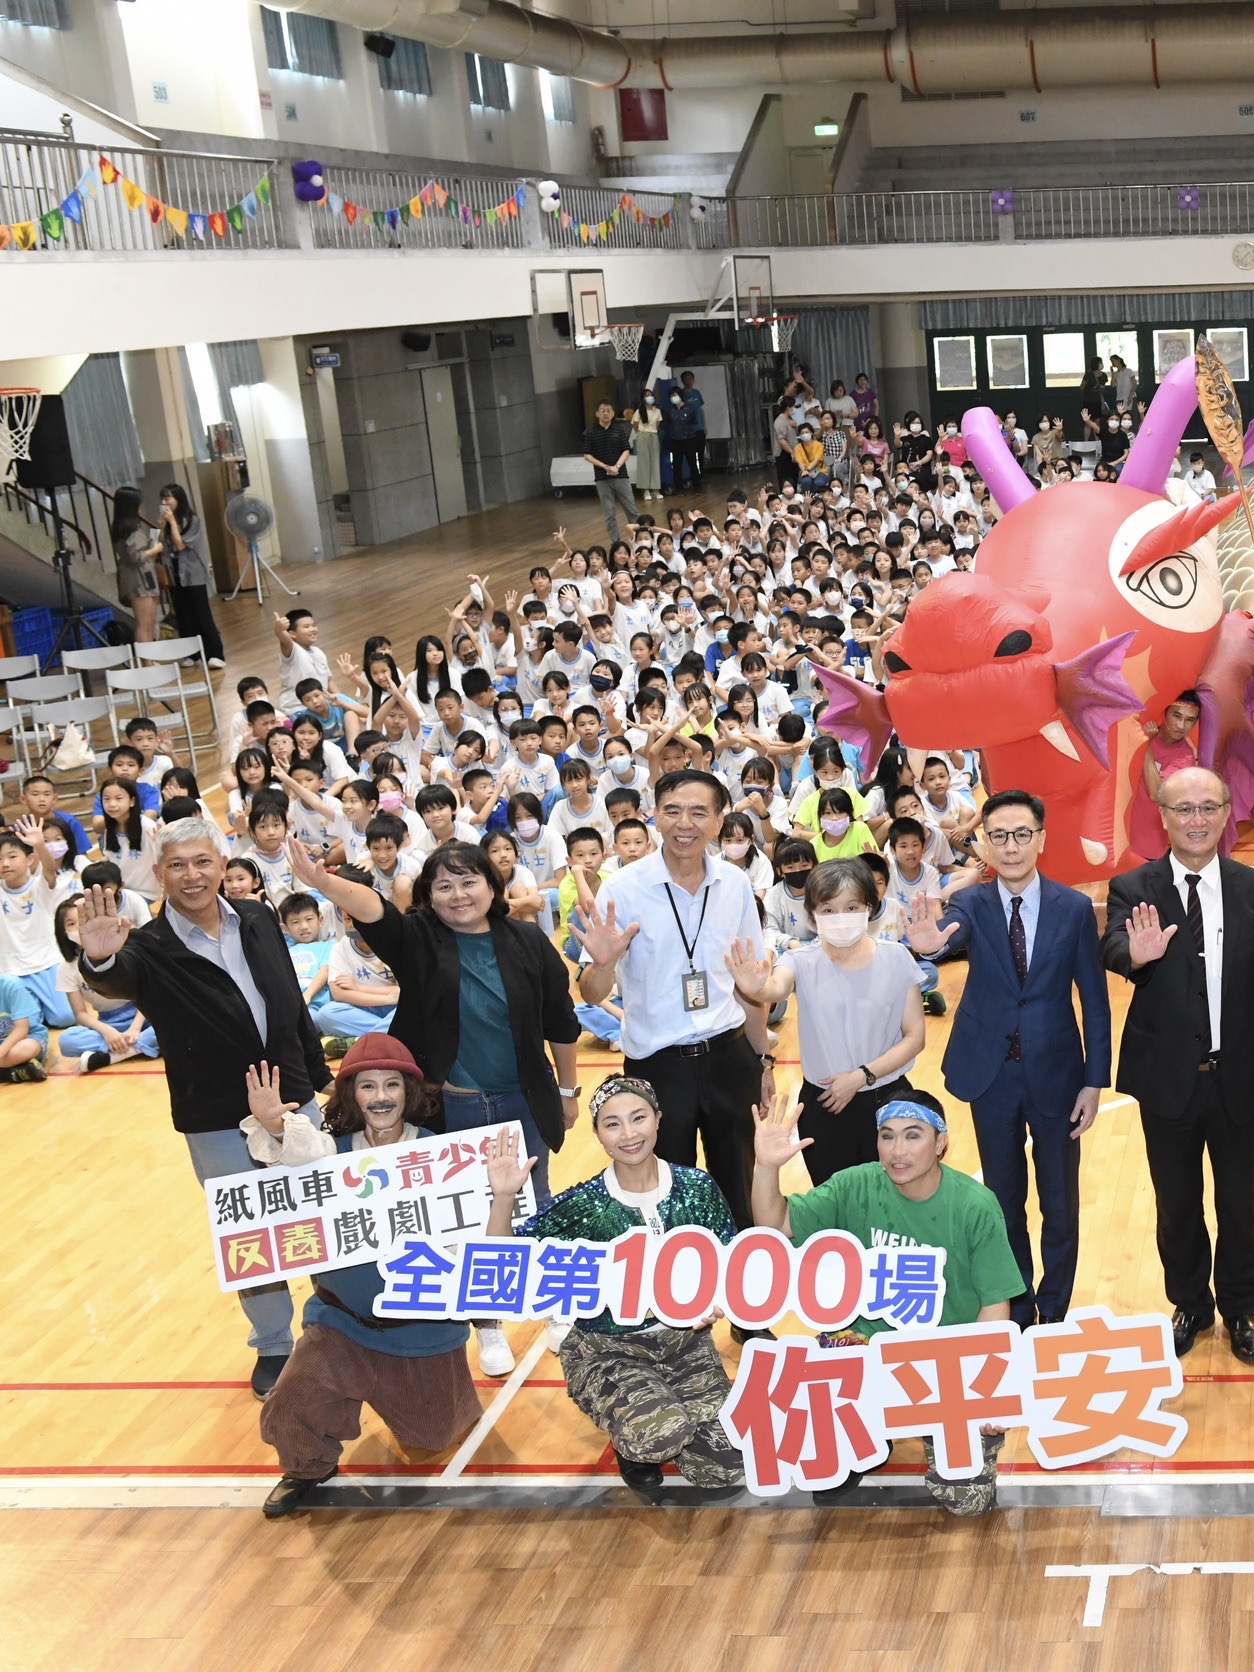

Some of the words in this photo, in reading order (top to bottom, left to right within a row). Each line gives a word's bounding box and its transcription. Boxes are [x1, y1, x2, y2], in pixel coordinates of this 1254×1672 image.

[1020, 112, 1036, 122] 607
[214, 1169, 338, 1226] 紙風車
[380, 1232, 940, 1325] 全國第1000場
[730, 1317, 1178, 1487] 你平安
